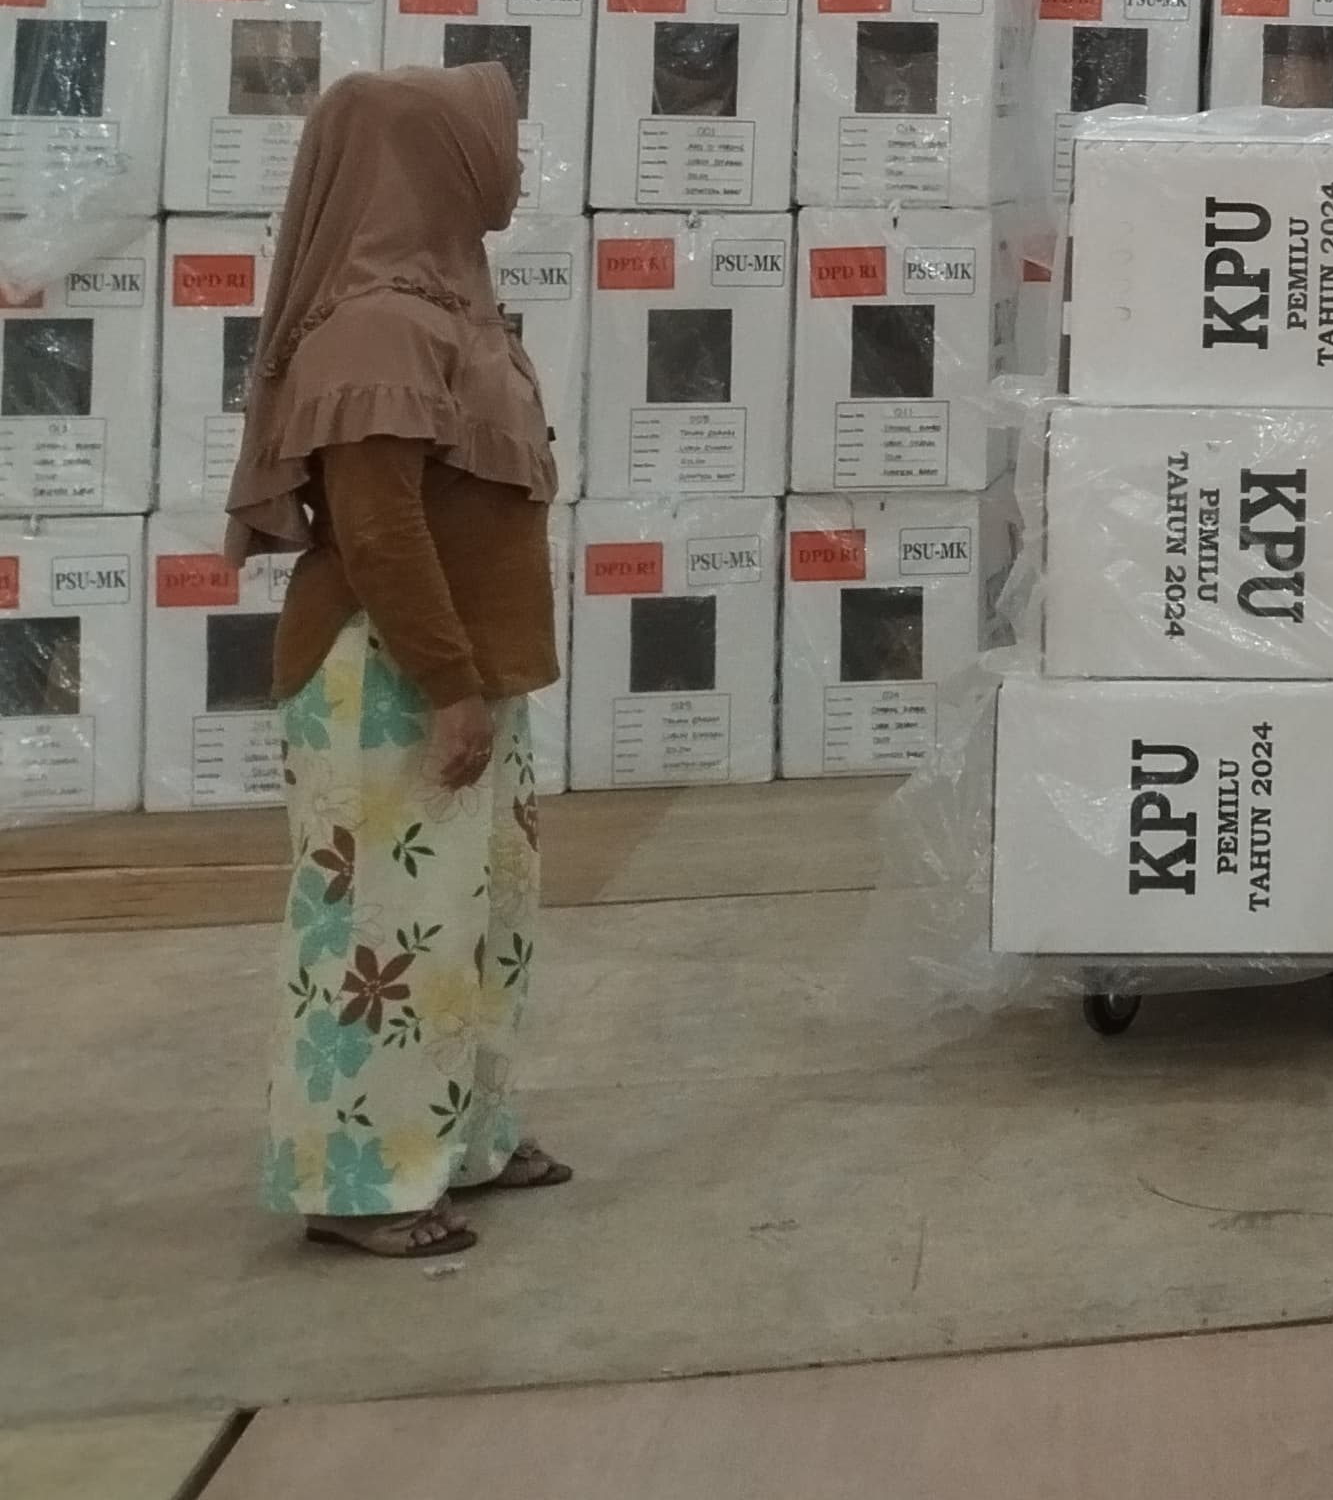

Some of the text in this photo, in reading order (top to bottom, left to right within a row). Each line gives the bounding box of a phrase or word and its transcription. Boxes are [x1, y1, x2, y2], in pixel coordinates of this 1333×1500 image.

[715, 253, 783, 272] PSU-MK
[817, 264, 878, 280] DPD RI
[905, 262, 972, 281] PSU-MK
[69, 273, 141, 292] PSU-MK
[183, 272, 246, 289] DPD RI
[500, 267, 568, 286] PSU-MK
[1203, 197, 1272, 350] KPU
[1287, 217, 1310, 331] PEMILU
[903, 542, 969, 561] PSU-MK
[1164, 451, 1189, 639] TAHUN 2024
[1197, 488, 1220, 605] PEMILU
[1237, 468, 1307, 623] KPU
[689, 550, 758, 572] PSU-MK
[799, 547, 859, 564] DPD RI
[593, 560, 657, 577] DPD RI
[55, 570, 127, 591] PSU-MK
[210, 571, 229, 587] RI
[1129, 739, 1200, 895] KPU
[1217, 758, 1241, 875] PEMILU
[1249, 721, 1274, 912] TAHUN 2024
